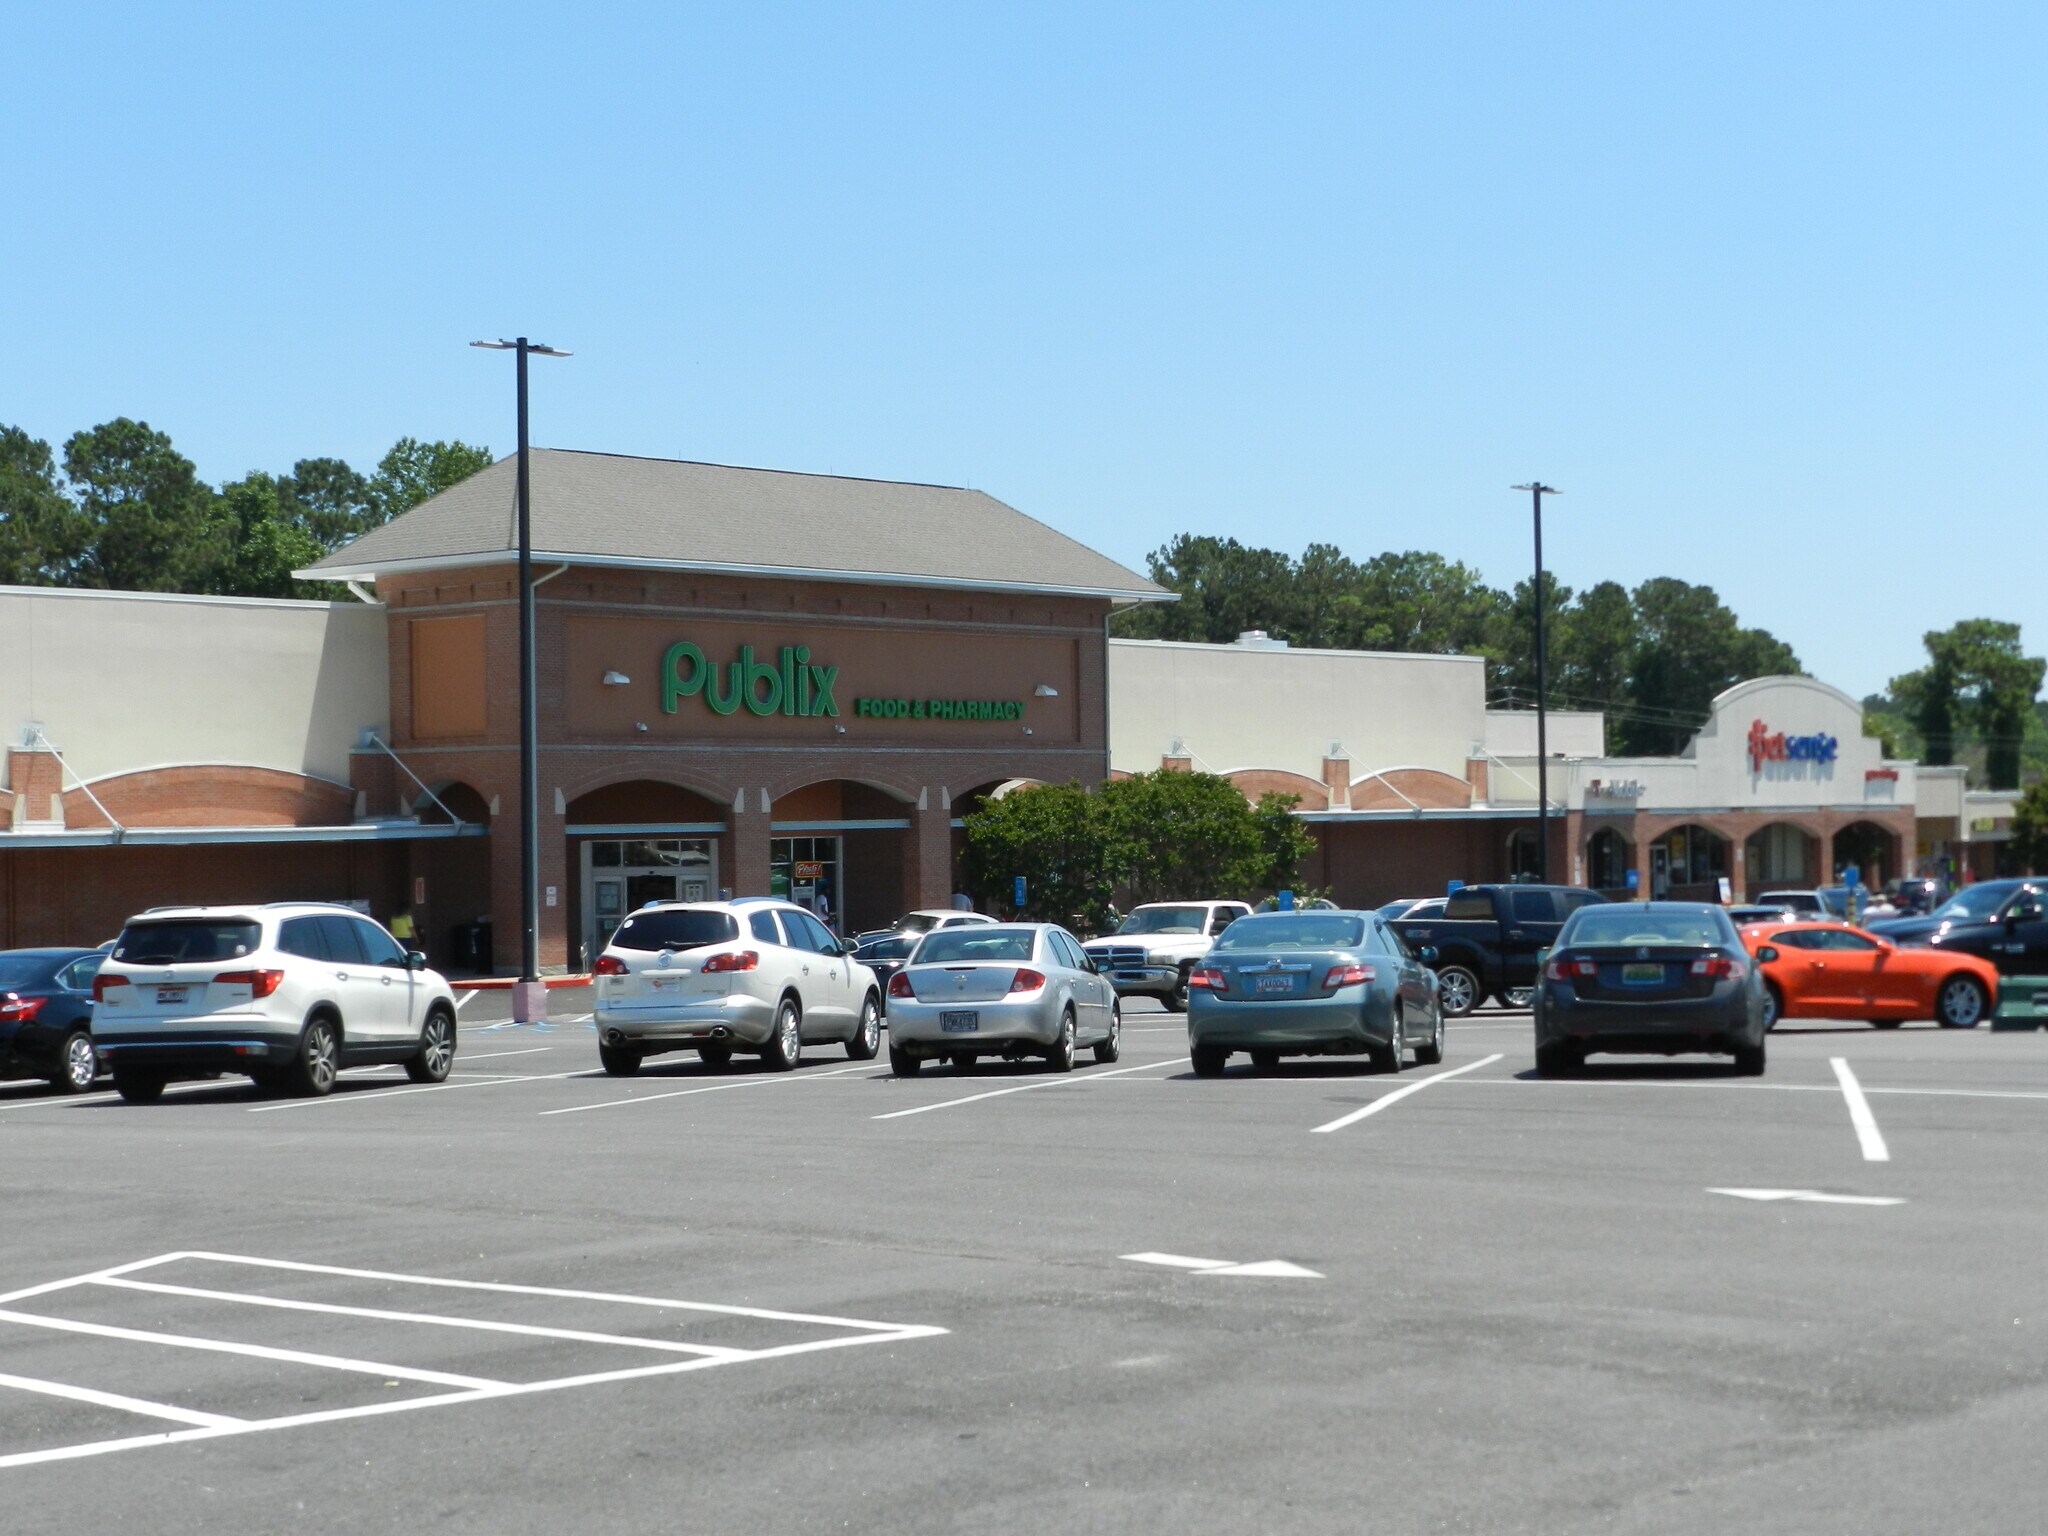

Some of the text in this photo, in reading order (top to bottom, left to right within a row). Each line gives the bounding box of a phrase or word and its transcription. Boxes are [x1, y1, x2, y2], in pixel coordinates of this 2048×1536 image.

[662, 641, 840, 717] Publix
[857, 699, 1026, 720] FOOD & PHARMACY
